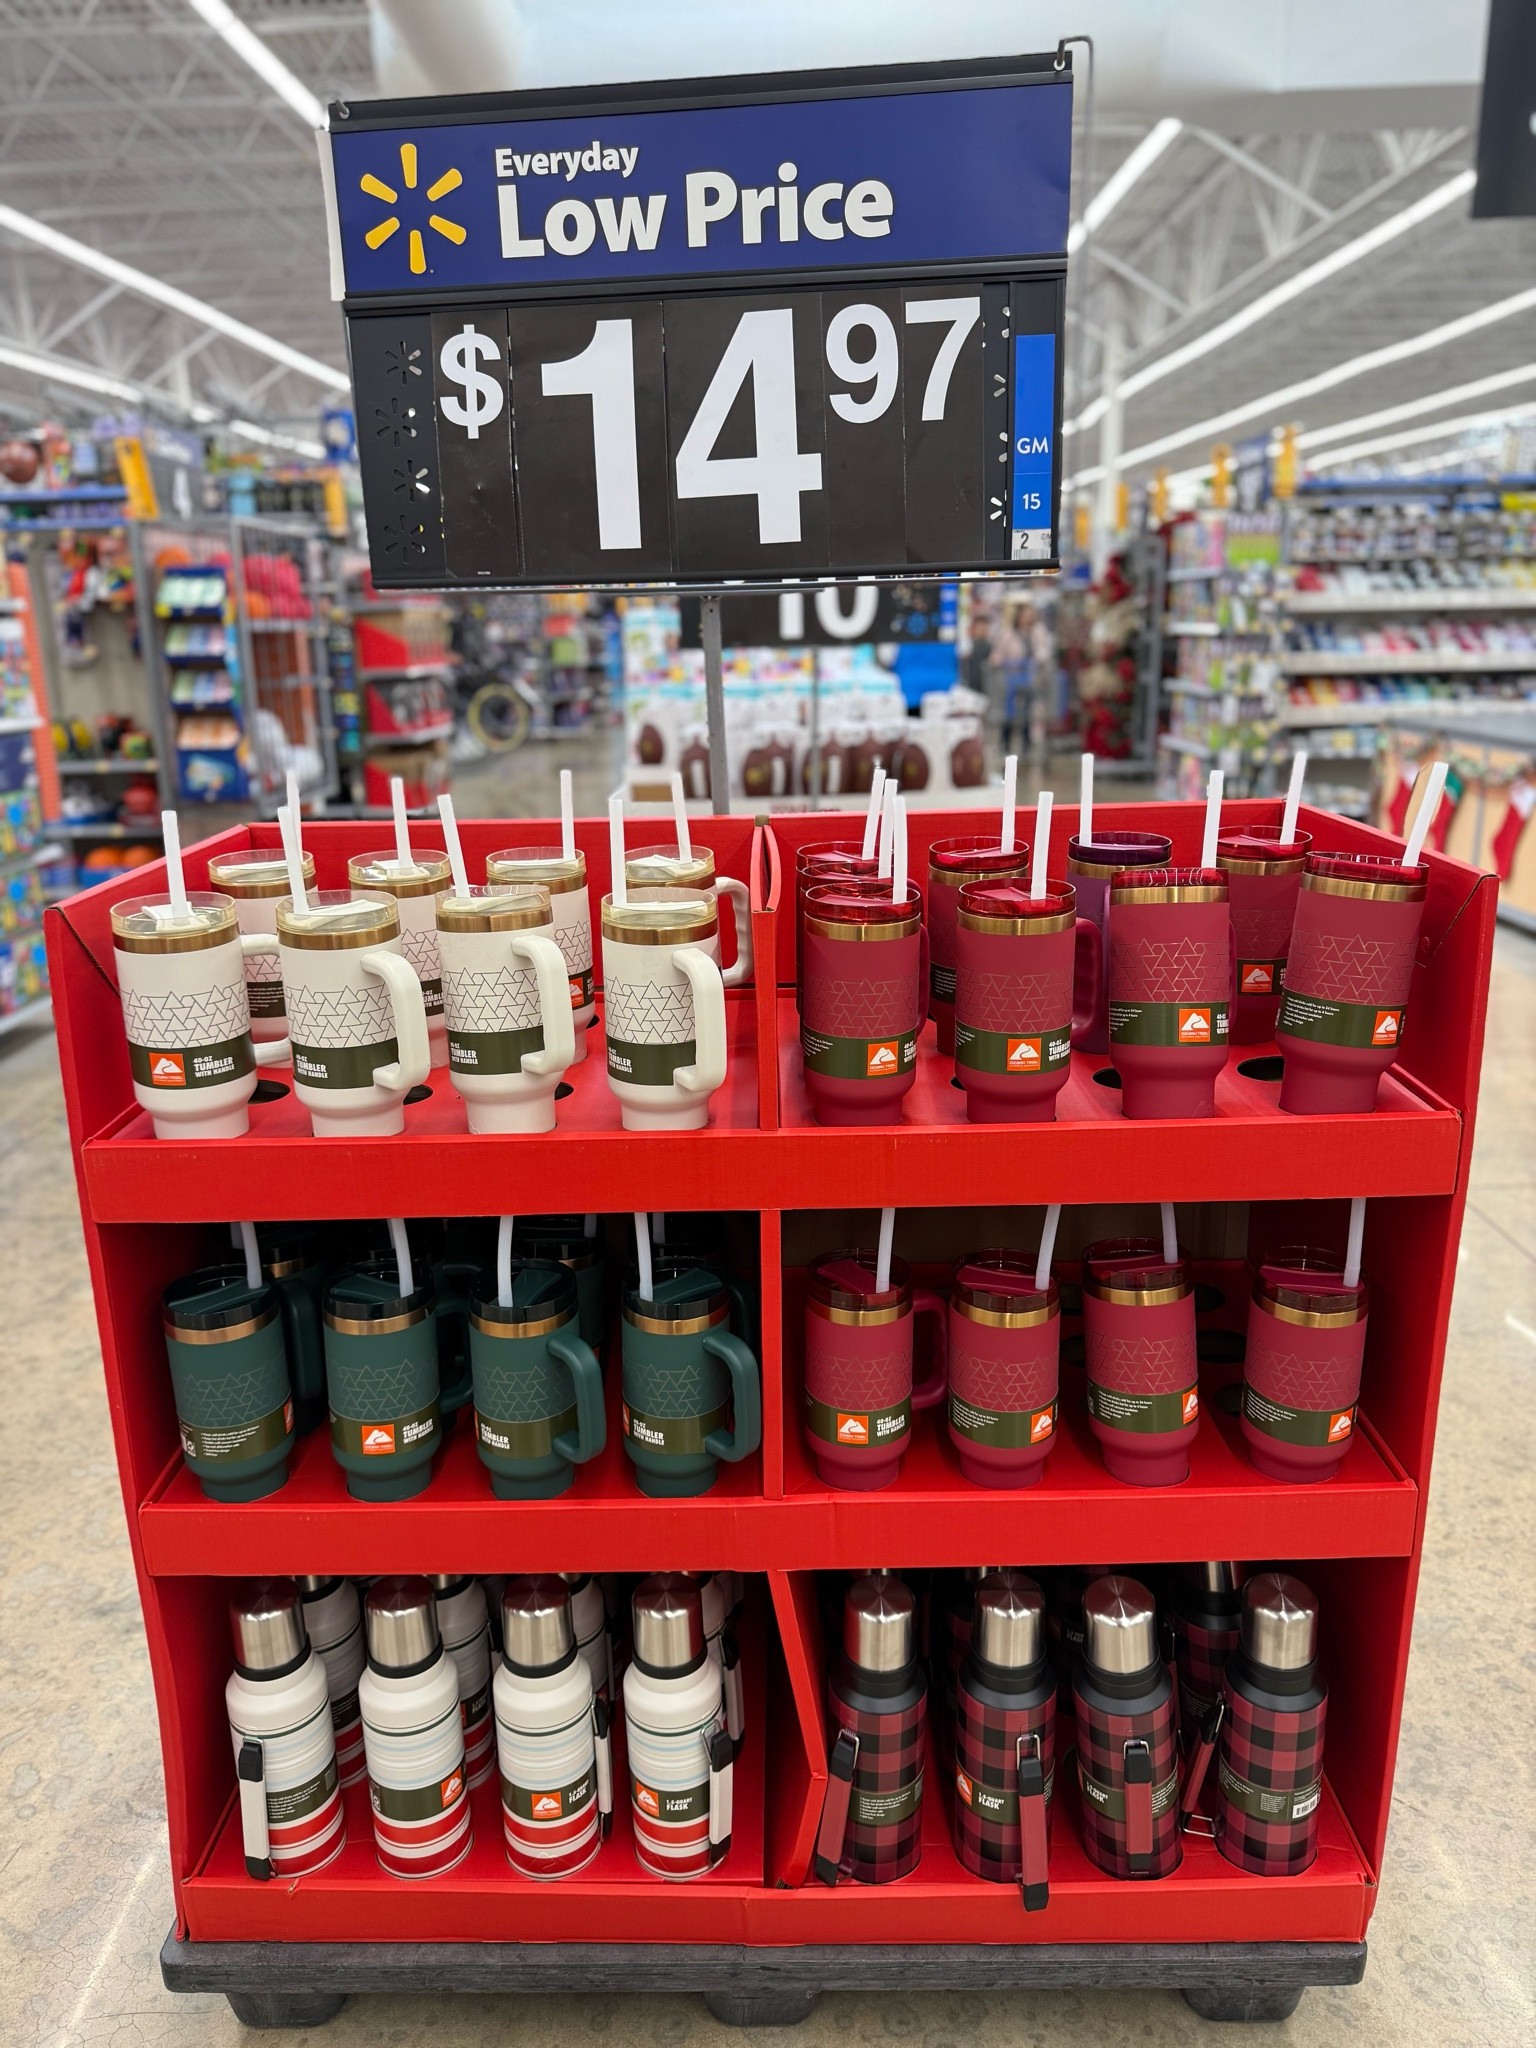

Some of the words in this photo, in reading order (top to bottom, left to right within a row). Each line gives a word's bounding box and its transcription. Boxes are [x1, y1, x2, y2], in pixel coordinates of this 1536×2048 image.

[495, 141, 639, 181] Everyday
[498, 185, 667, 259] Low
[685, 162, 894, 248] Price
[1016, 437, 1049, 455] GM
[1022, 493, 1041, 510] 15
[1020, 533, 1029, 549] 2
[193, 1055, 213, 1063] 40-OZ
[451, 1047, 477, 1059] TUMBLER
[608, 1052, 631, 1067] TUMBLER
[193, 1056, 233, 1071] TUMBLER
[296, 1060, 327, 1073] TUMBLER
[460, 1056, 478, 1065] HANDLE
[195, 1070, 212, 1078] WITH
[213, 1063, 235, 1075] HANDLE
[308, 1070, 328, 1079] HANDLE
[616, 1063, 633, 1073] HANDLE
[402, 1421, 418, 1431] 40-OZ
[876, 1415, 892, 1424] 40-OZ
[877, 1415, 905, 1432] TUMBLER
[403, 1418, 433, 1438] TUMBLER
[633, 1423, 664, 1440] TUMBLER
[877, 1429, 890, 1437] WITH
[403, 1435, 417, 1445] WITH
[481, 1427, 509, 1444] TUMBLER
[647, 1434, 665, 1446] HANDLE
[491, 1440, 511, 1450] HANDLE
[569, 1786, 587, 1804] FLASK
[666, 1797, 693, 1805] 1.5-QUART
[1087, 1787, 1105, 1804] FLASK
[666, 1803, 688, 1811] FLASK
[979, 1797, 1000, 1810] FLASK
